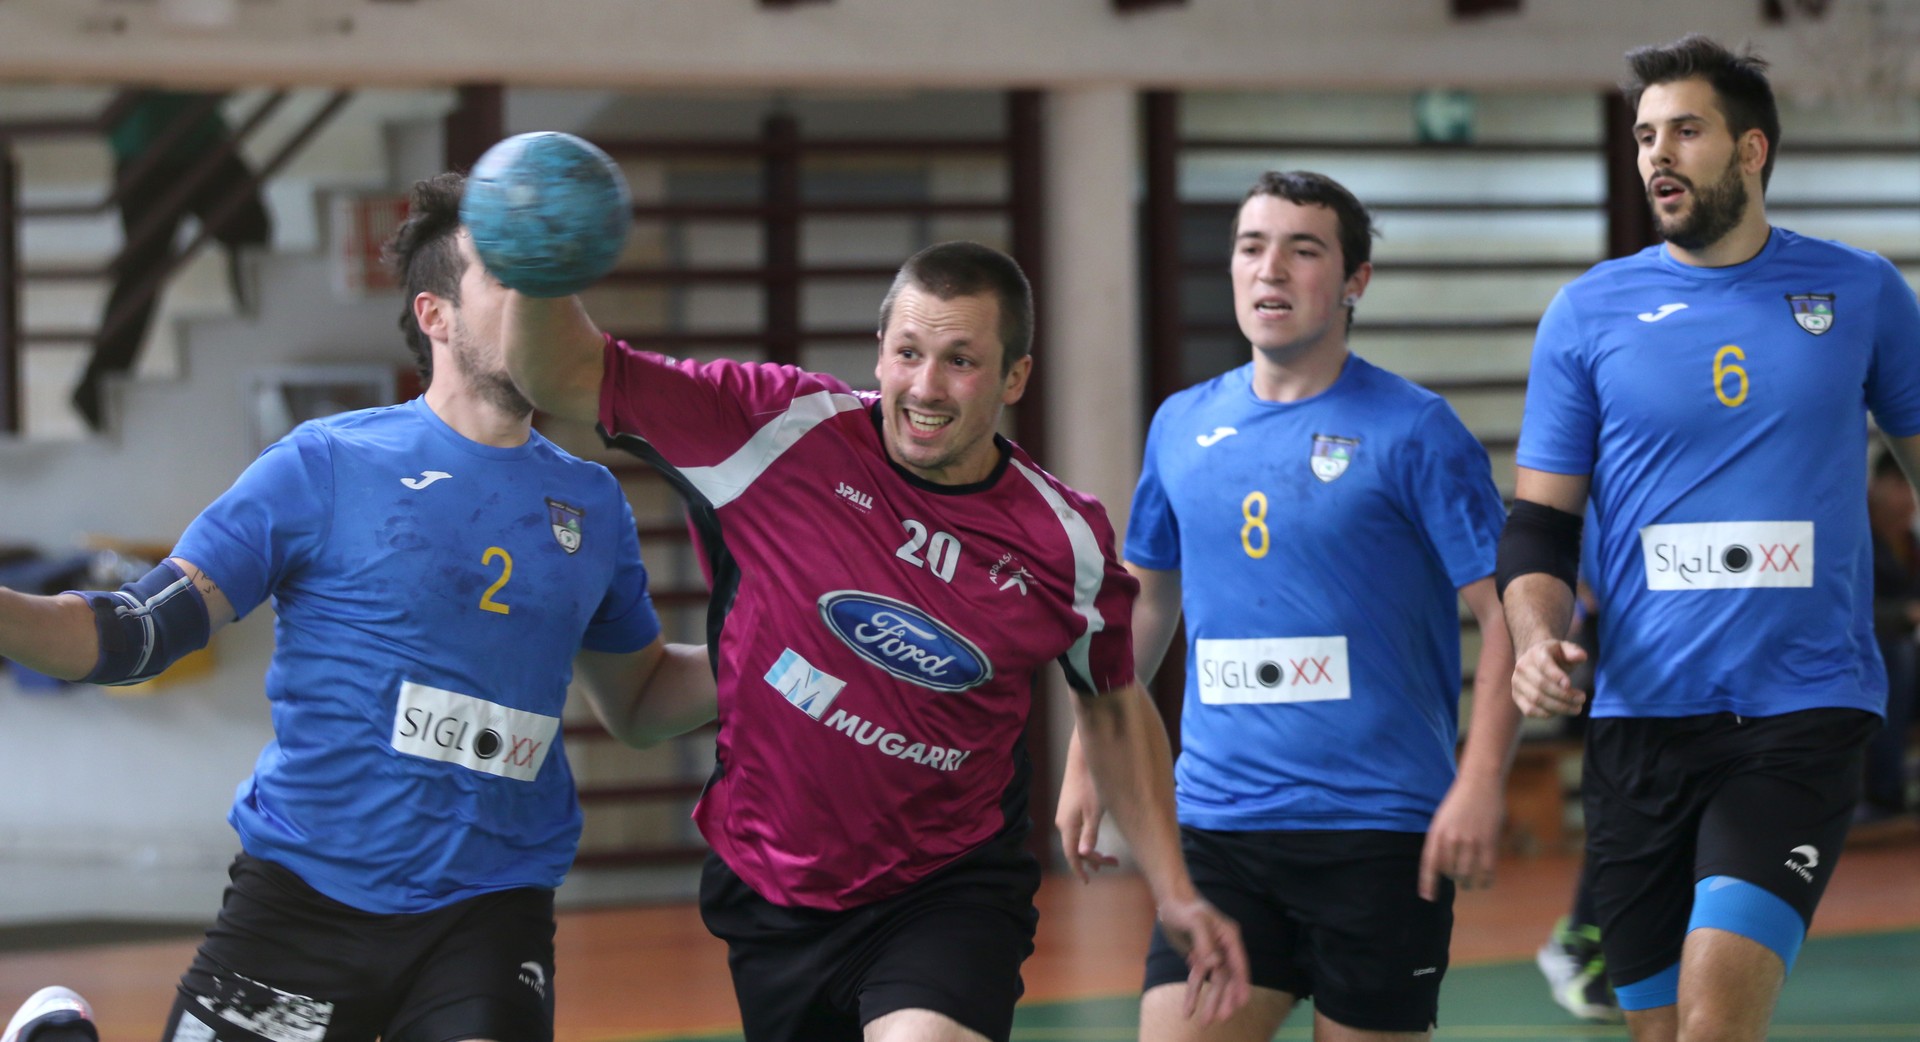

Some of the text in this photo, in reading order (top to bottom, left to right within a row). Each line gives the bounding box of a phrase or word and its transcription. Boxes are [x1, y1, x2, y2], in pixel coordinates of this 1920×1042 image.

[1713, 344, 1749, 408] 6
[835, 481, 873, 510] SPALL
[1241, 491, 1270, 559] 8
[479, 546, 513, 615] 2
[895, 519, 962, 584] 20
[854, 611, 957, 677] Ford
[824, 708, 971, 771] MUGARRI
